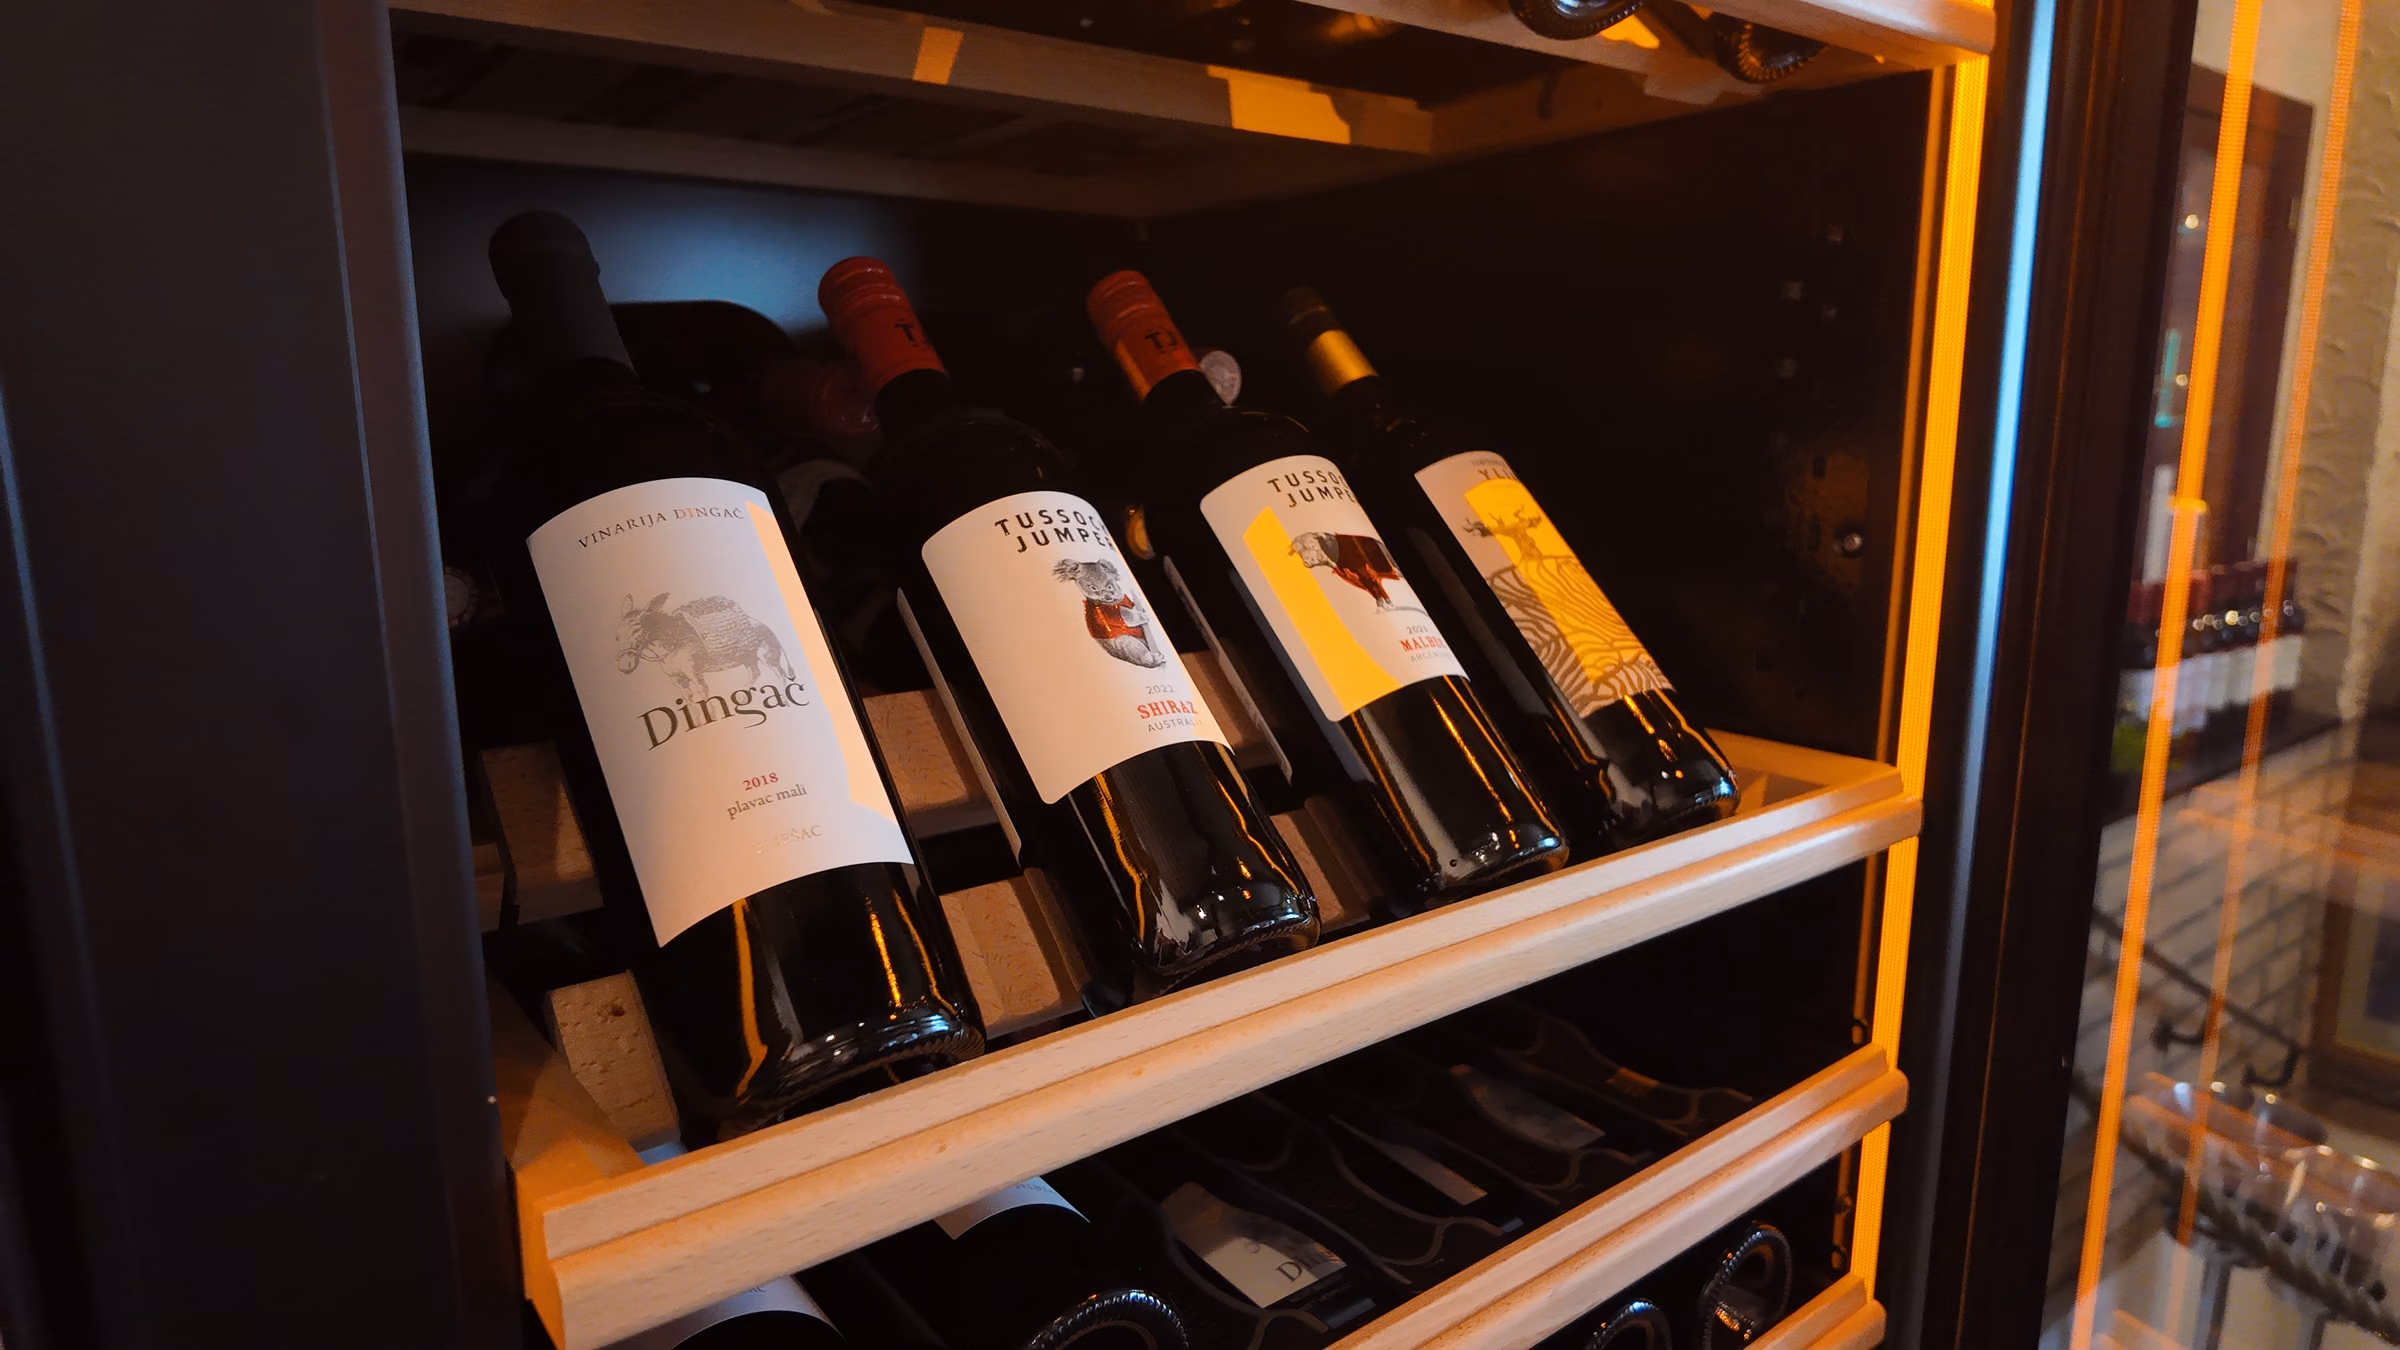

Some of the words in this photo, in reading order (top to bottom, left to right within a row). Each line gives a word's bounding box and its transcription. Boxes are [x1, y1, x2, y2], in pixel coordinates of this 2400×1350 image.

[578, 512, 668, 549] VINARIJA
[673, 507, 745, 521] DINGAČ
[1145, 684, 1175, 695] 2022
[637, 676, 811, 751] Dingač
[1137, 699, 1199, 720] SHIRAZ
[742, 772, 779, 792] 2018
[727, 792, 774, 820] plavac
[776, 783, 808, 803] mali
